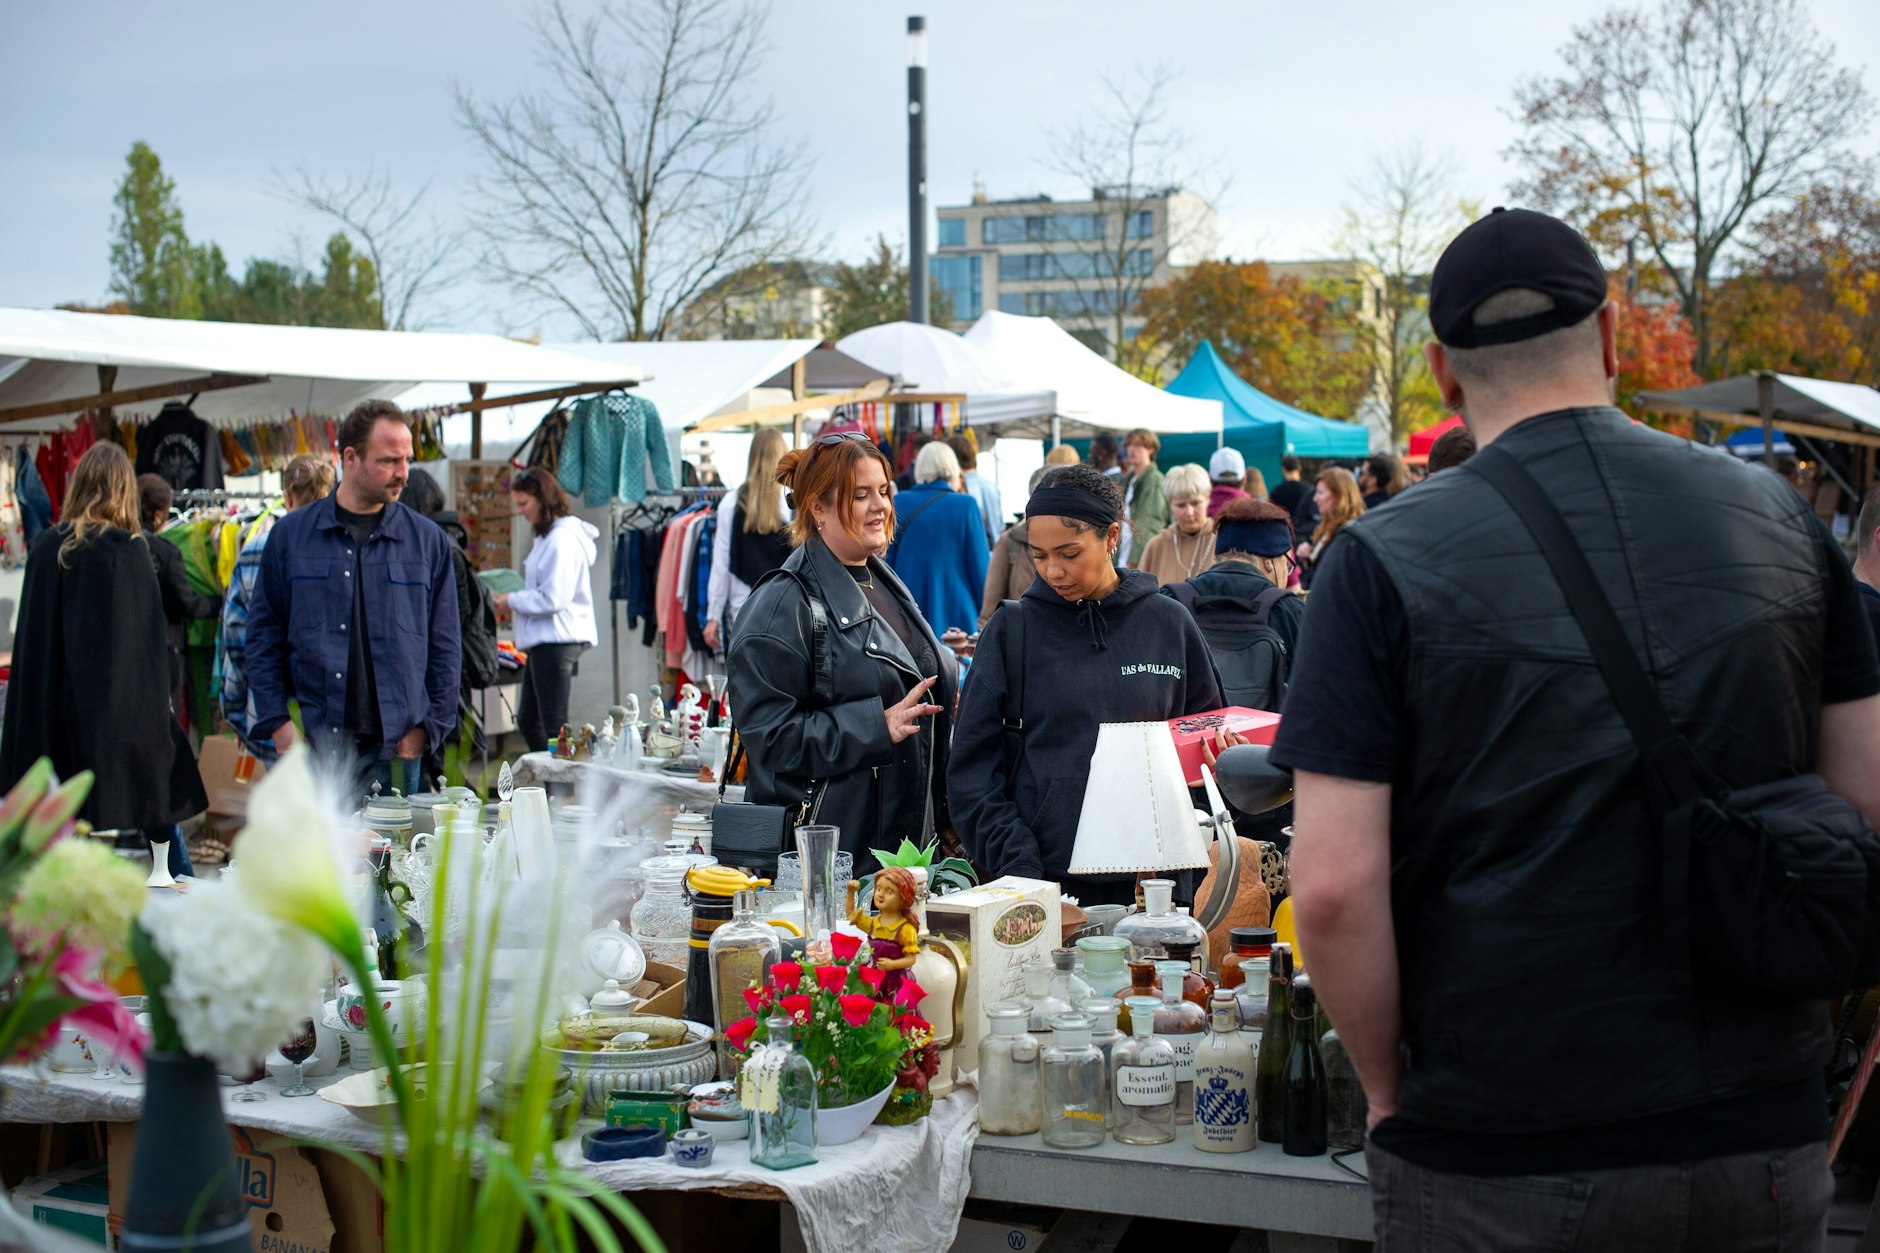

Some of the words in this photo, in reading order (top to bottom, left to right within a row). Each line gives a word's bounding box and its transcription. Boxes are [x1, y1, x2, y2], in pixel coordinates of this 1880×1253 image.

[1121, 664, 1137, 676] L'AS
[1137, 663, 1147, 672] du
[1146, 664, 1181, 680] FALLAFEL
[1128, 1072, 1168, 1082] Essent.
[261, 1234, 327, 1253] BANAN
